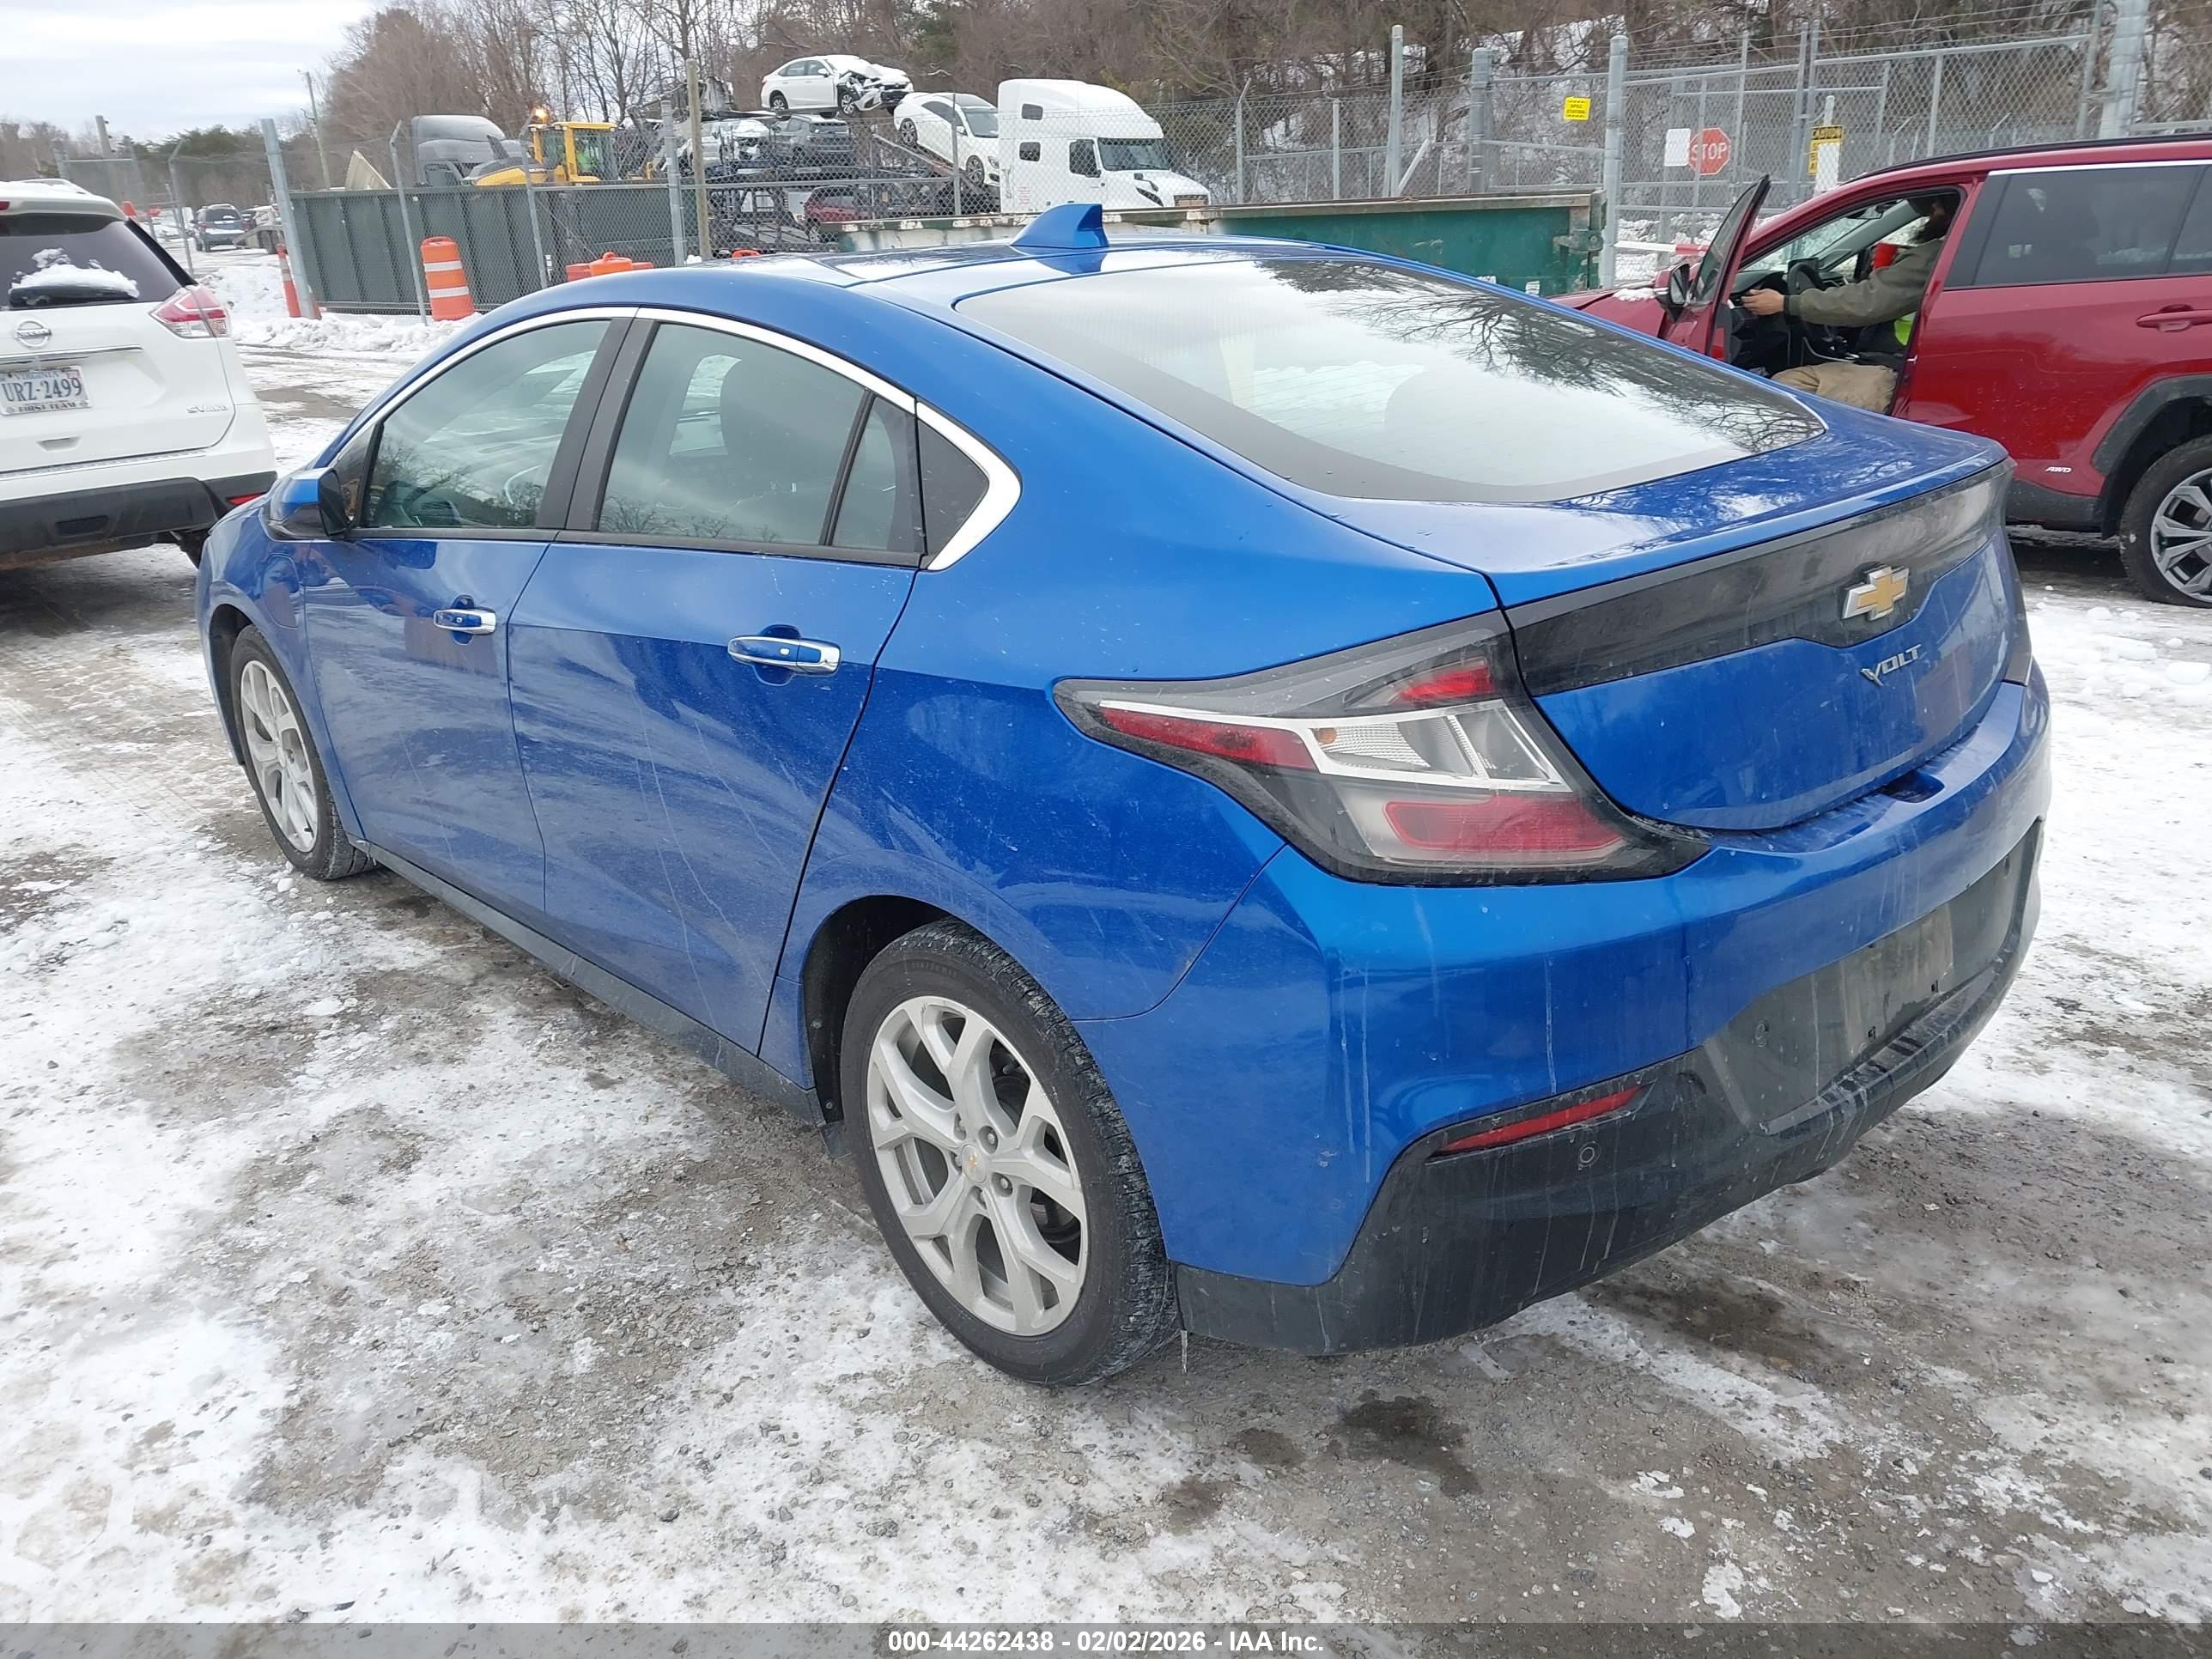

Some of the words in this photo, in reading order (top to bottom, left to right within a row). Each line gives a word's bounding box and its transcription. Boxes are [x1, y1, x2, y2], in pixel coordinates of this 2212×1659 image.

[1690, 142, 1728, 161] STOP
[1, 377, 82, 402] URZ-2499
[1861, 644, 1922, 687] VOLT
